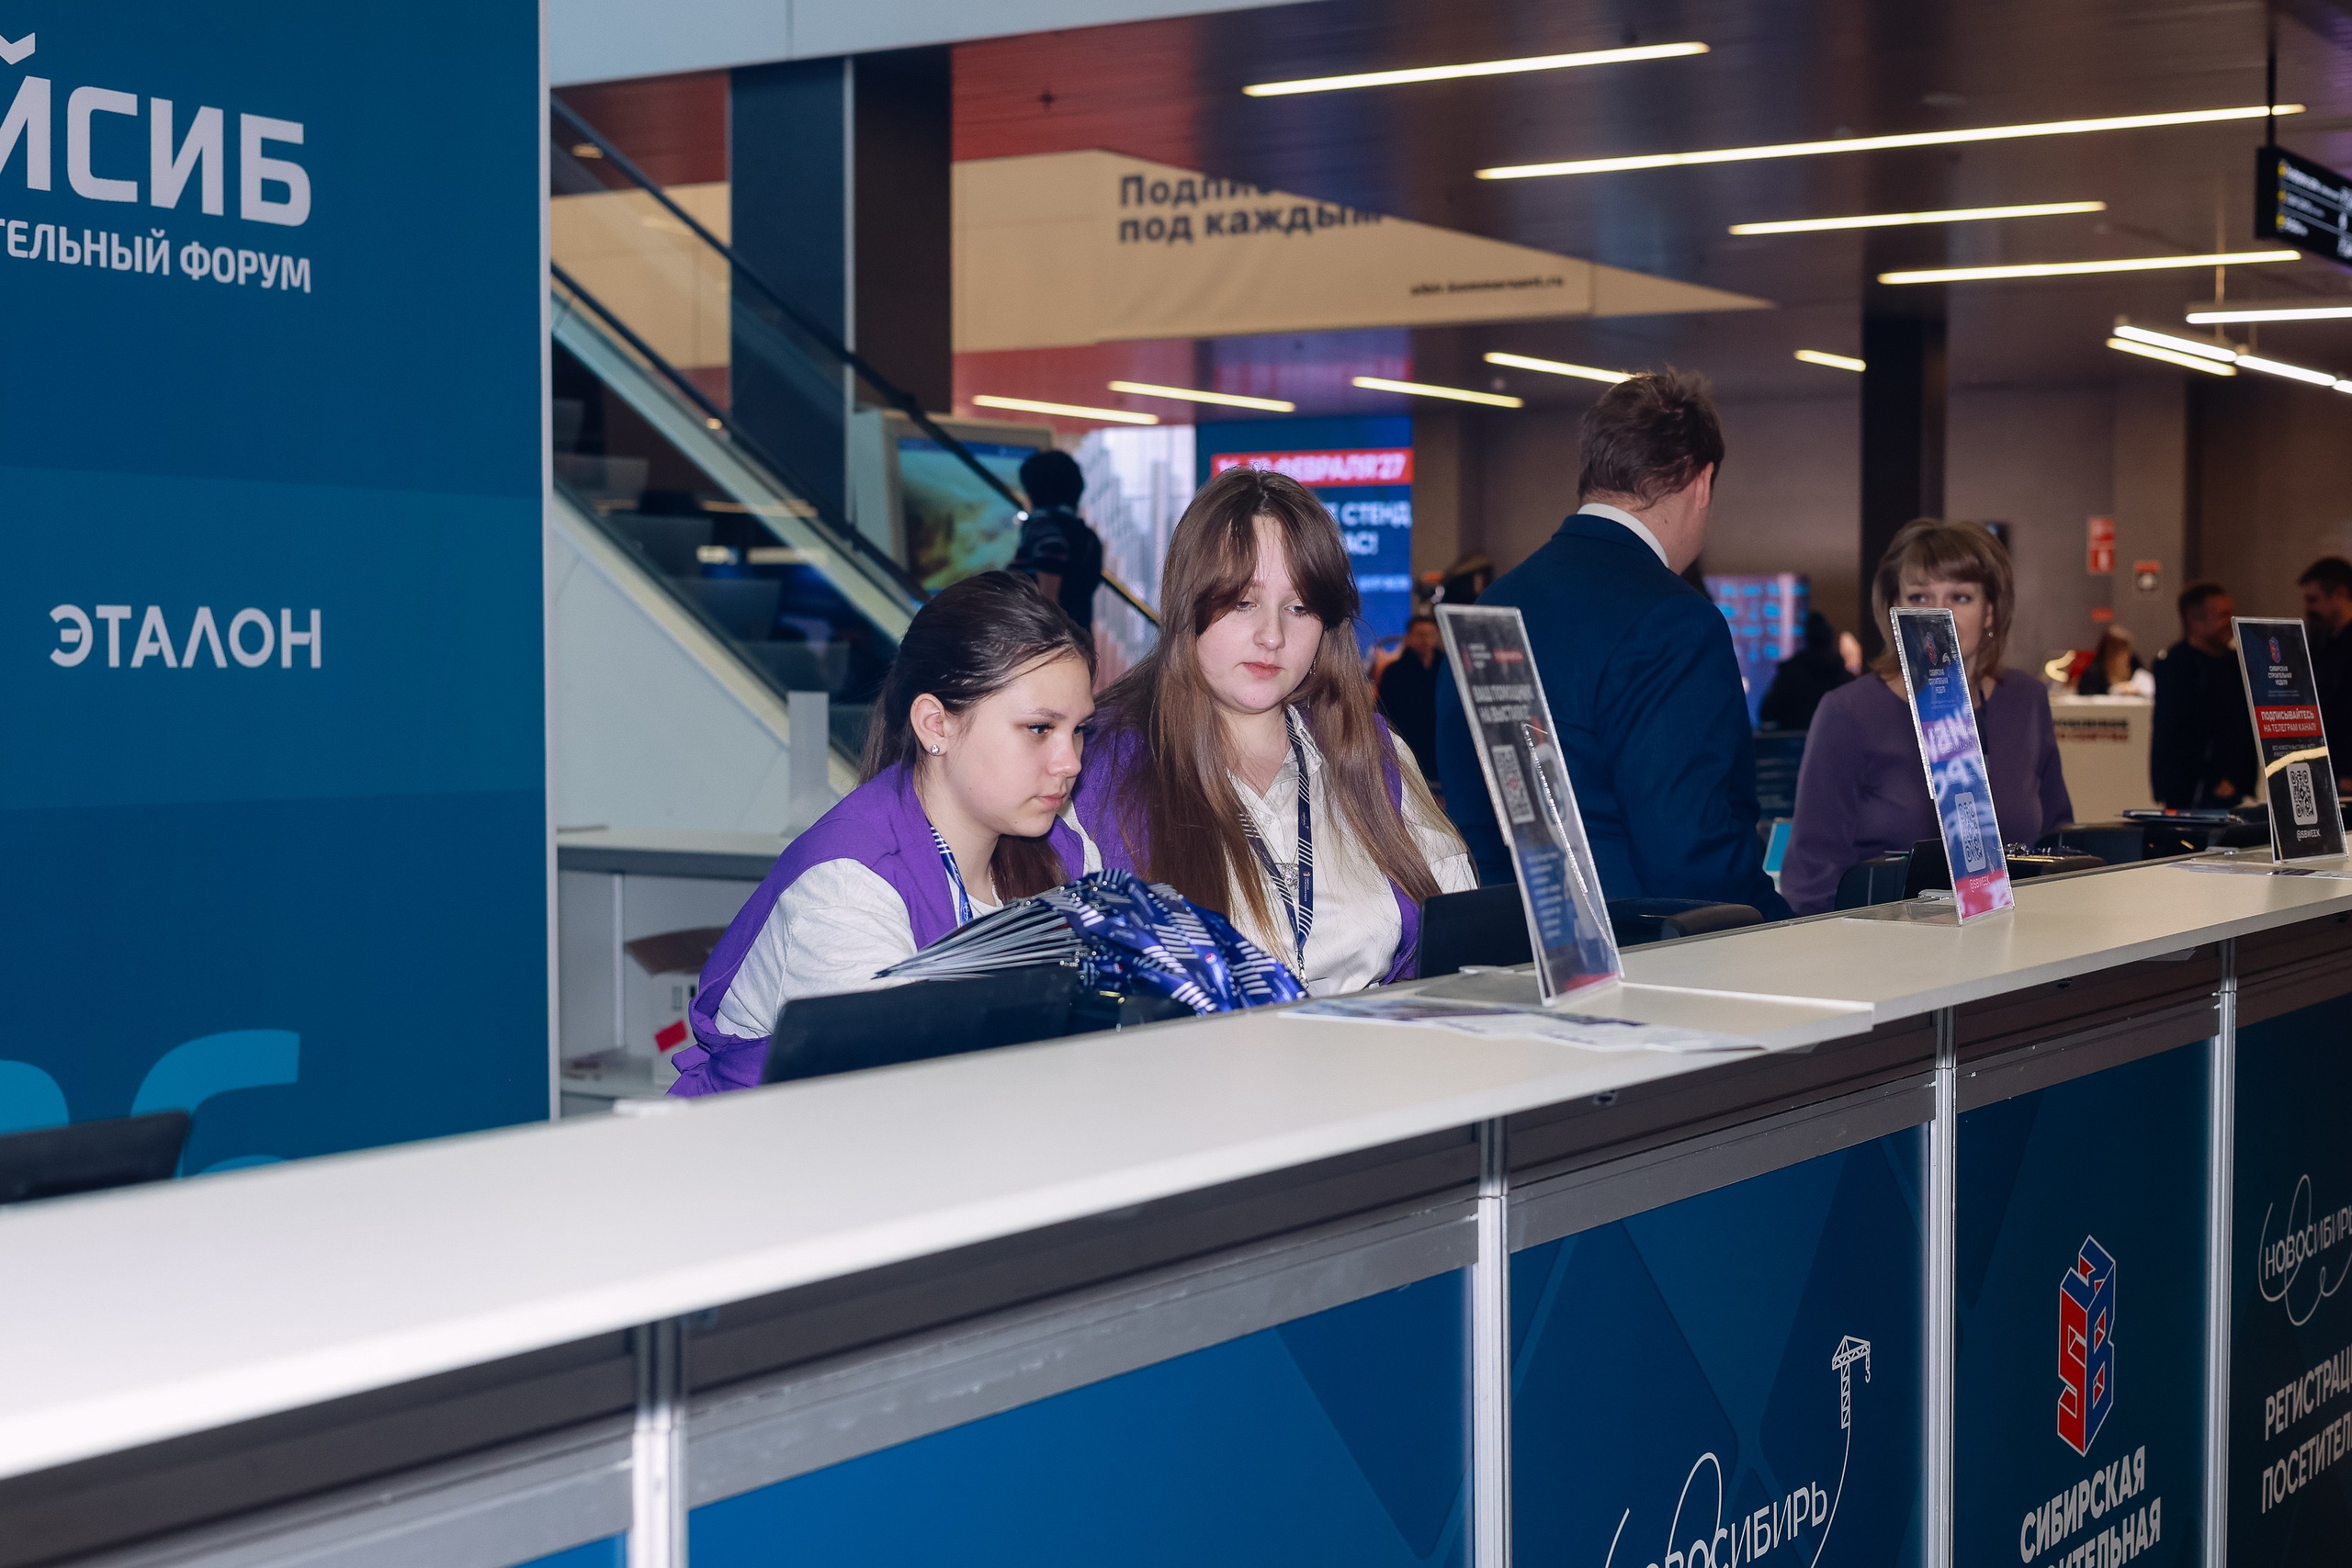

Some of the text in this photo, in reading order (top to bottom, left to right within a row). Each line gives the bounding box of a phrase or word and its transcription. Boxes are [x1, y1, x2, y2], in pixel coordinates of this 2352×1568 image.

[1120, 214, 1193, 244] под
[180, 241, 311, 294] ФОРУМ
[50, 604, 322, 669] ЭТАЛОН
[2261, 708, 2314, 722] ПОДПИСЫВАЙТЕСЬ
[2264, 724, 2272, 732] НА
[2271, 723, 2298, 732] ТЕЛЕГРАМ
[2266, 1344, 2352, 1441] РЕГИСТРАЦ
[2262, 1410, 2352, 1515] ПОСЕТИТЕЛ
[2020, 1445, 2145, 1563] СИБИРСКАЯ
